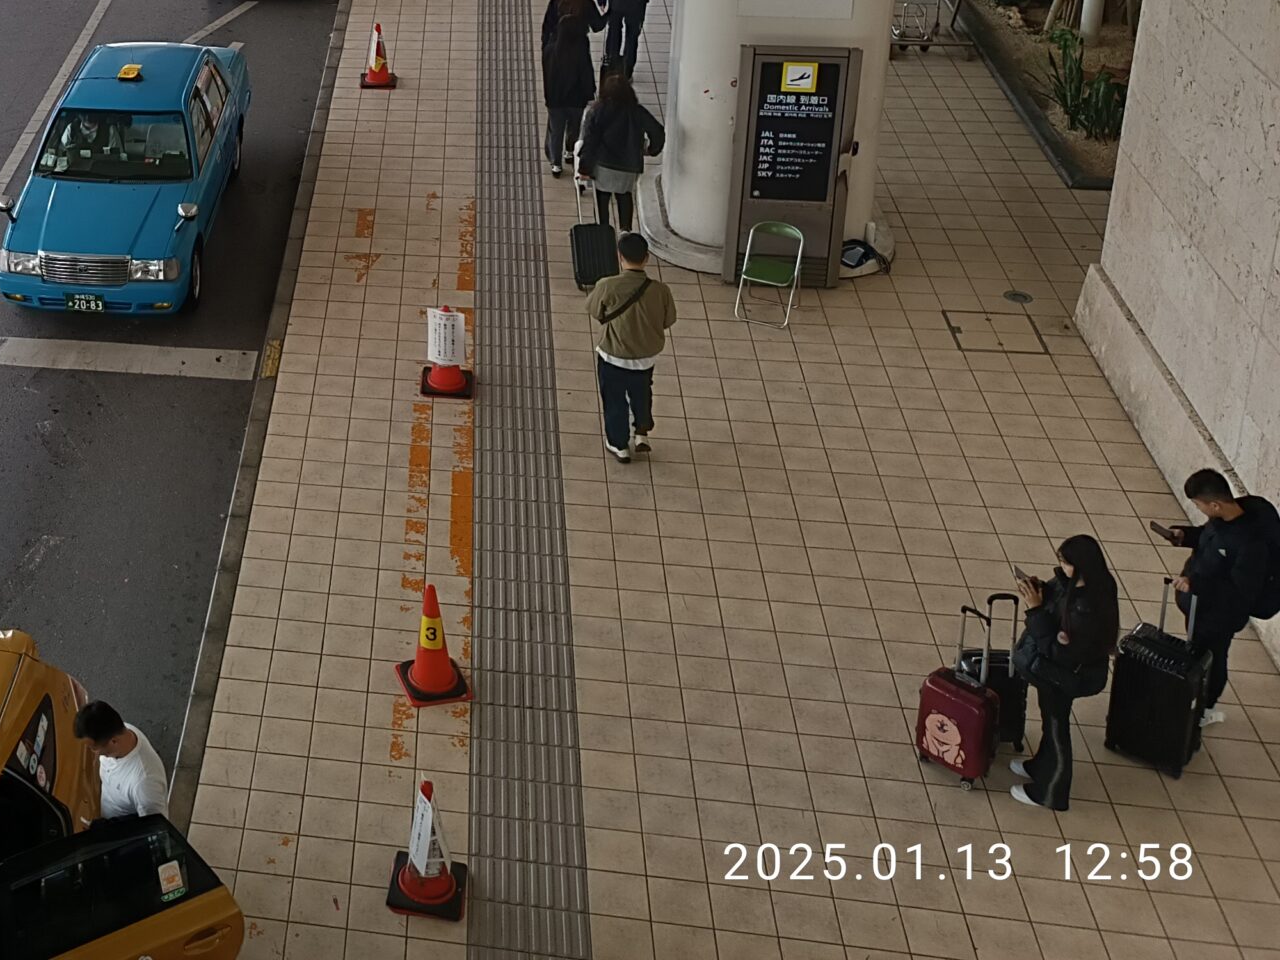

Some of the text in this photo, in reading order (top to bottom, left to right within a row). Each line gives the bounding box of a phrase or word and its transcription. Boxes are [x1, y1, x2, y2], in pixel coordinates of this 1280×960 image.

[766, 94, 797, 103] 国内線
[763, 103, 798, 111] Domestic
[761, 130, 774, 138] JAL
[760, 138, 774, 146] JTA
[759, 146, 775, 154] RAC
[425, 627, 437, 641] 3
